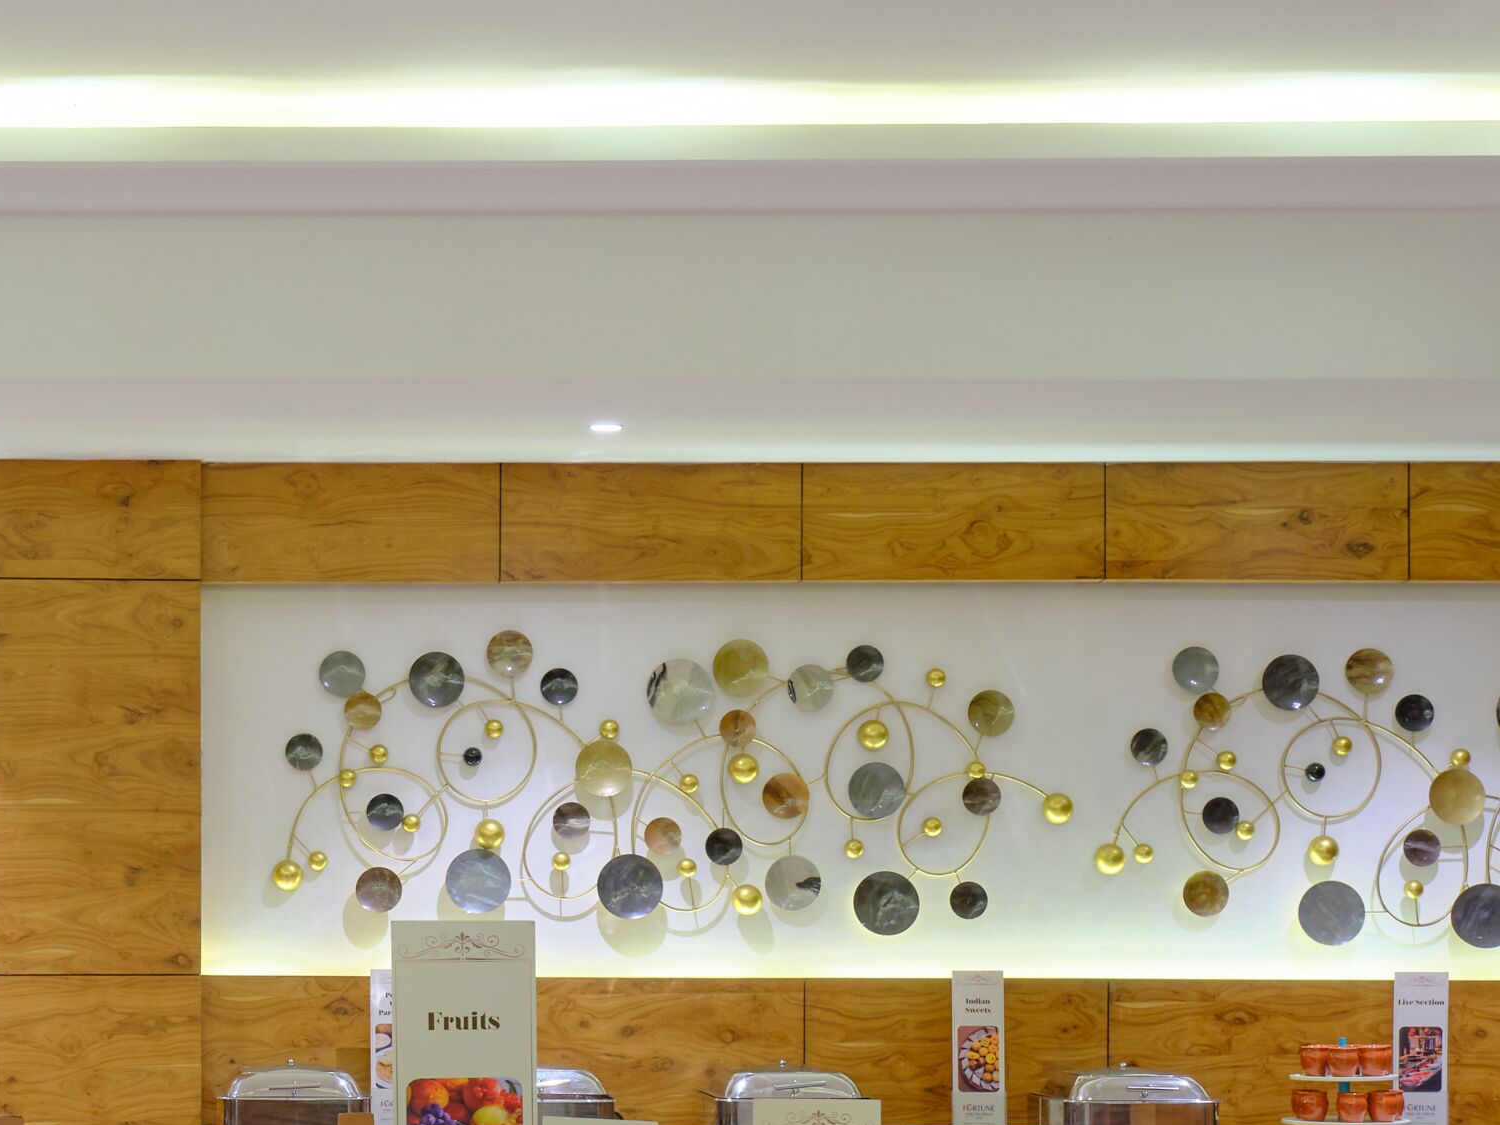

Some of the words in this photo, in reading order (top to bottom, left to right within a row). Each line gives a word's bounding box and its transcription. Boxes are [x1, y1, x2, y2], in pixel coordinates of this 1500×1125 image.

[965, 997, 991, 1005] Indian
[1398, 998, 1414, 1006] Live
[1415, 998, 1445, 1006] Section
[427, 1011, 501, 1031] Fruits
[962, 1103, 995, 1112] FORTUNE
